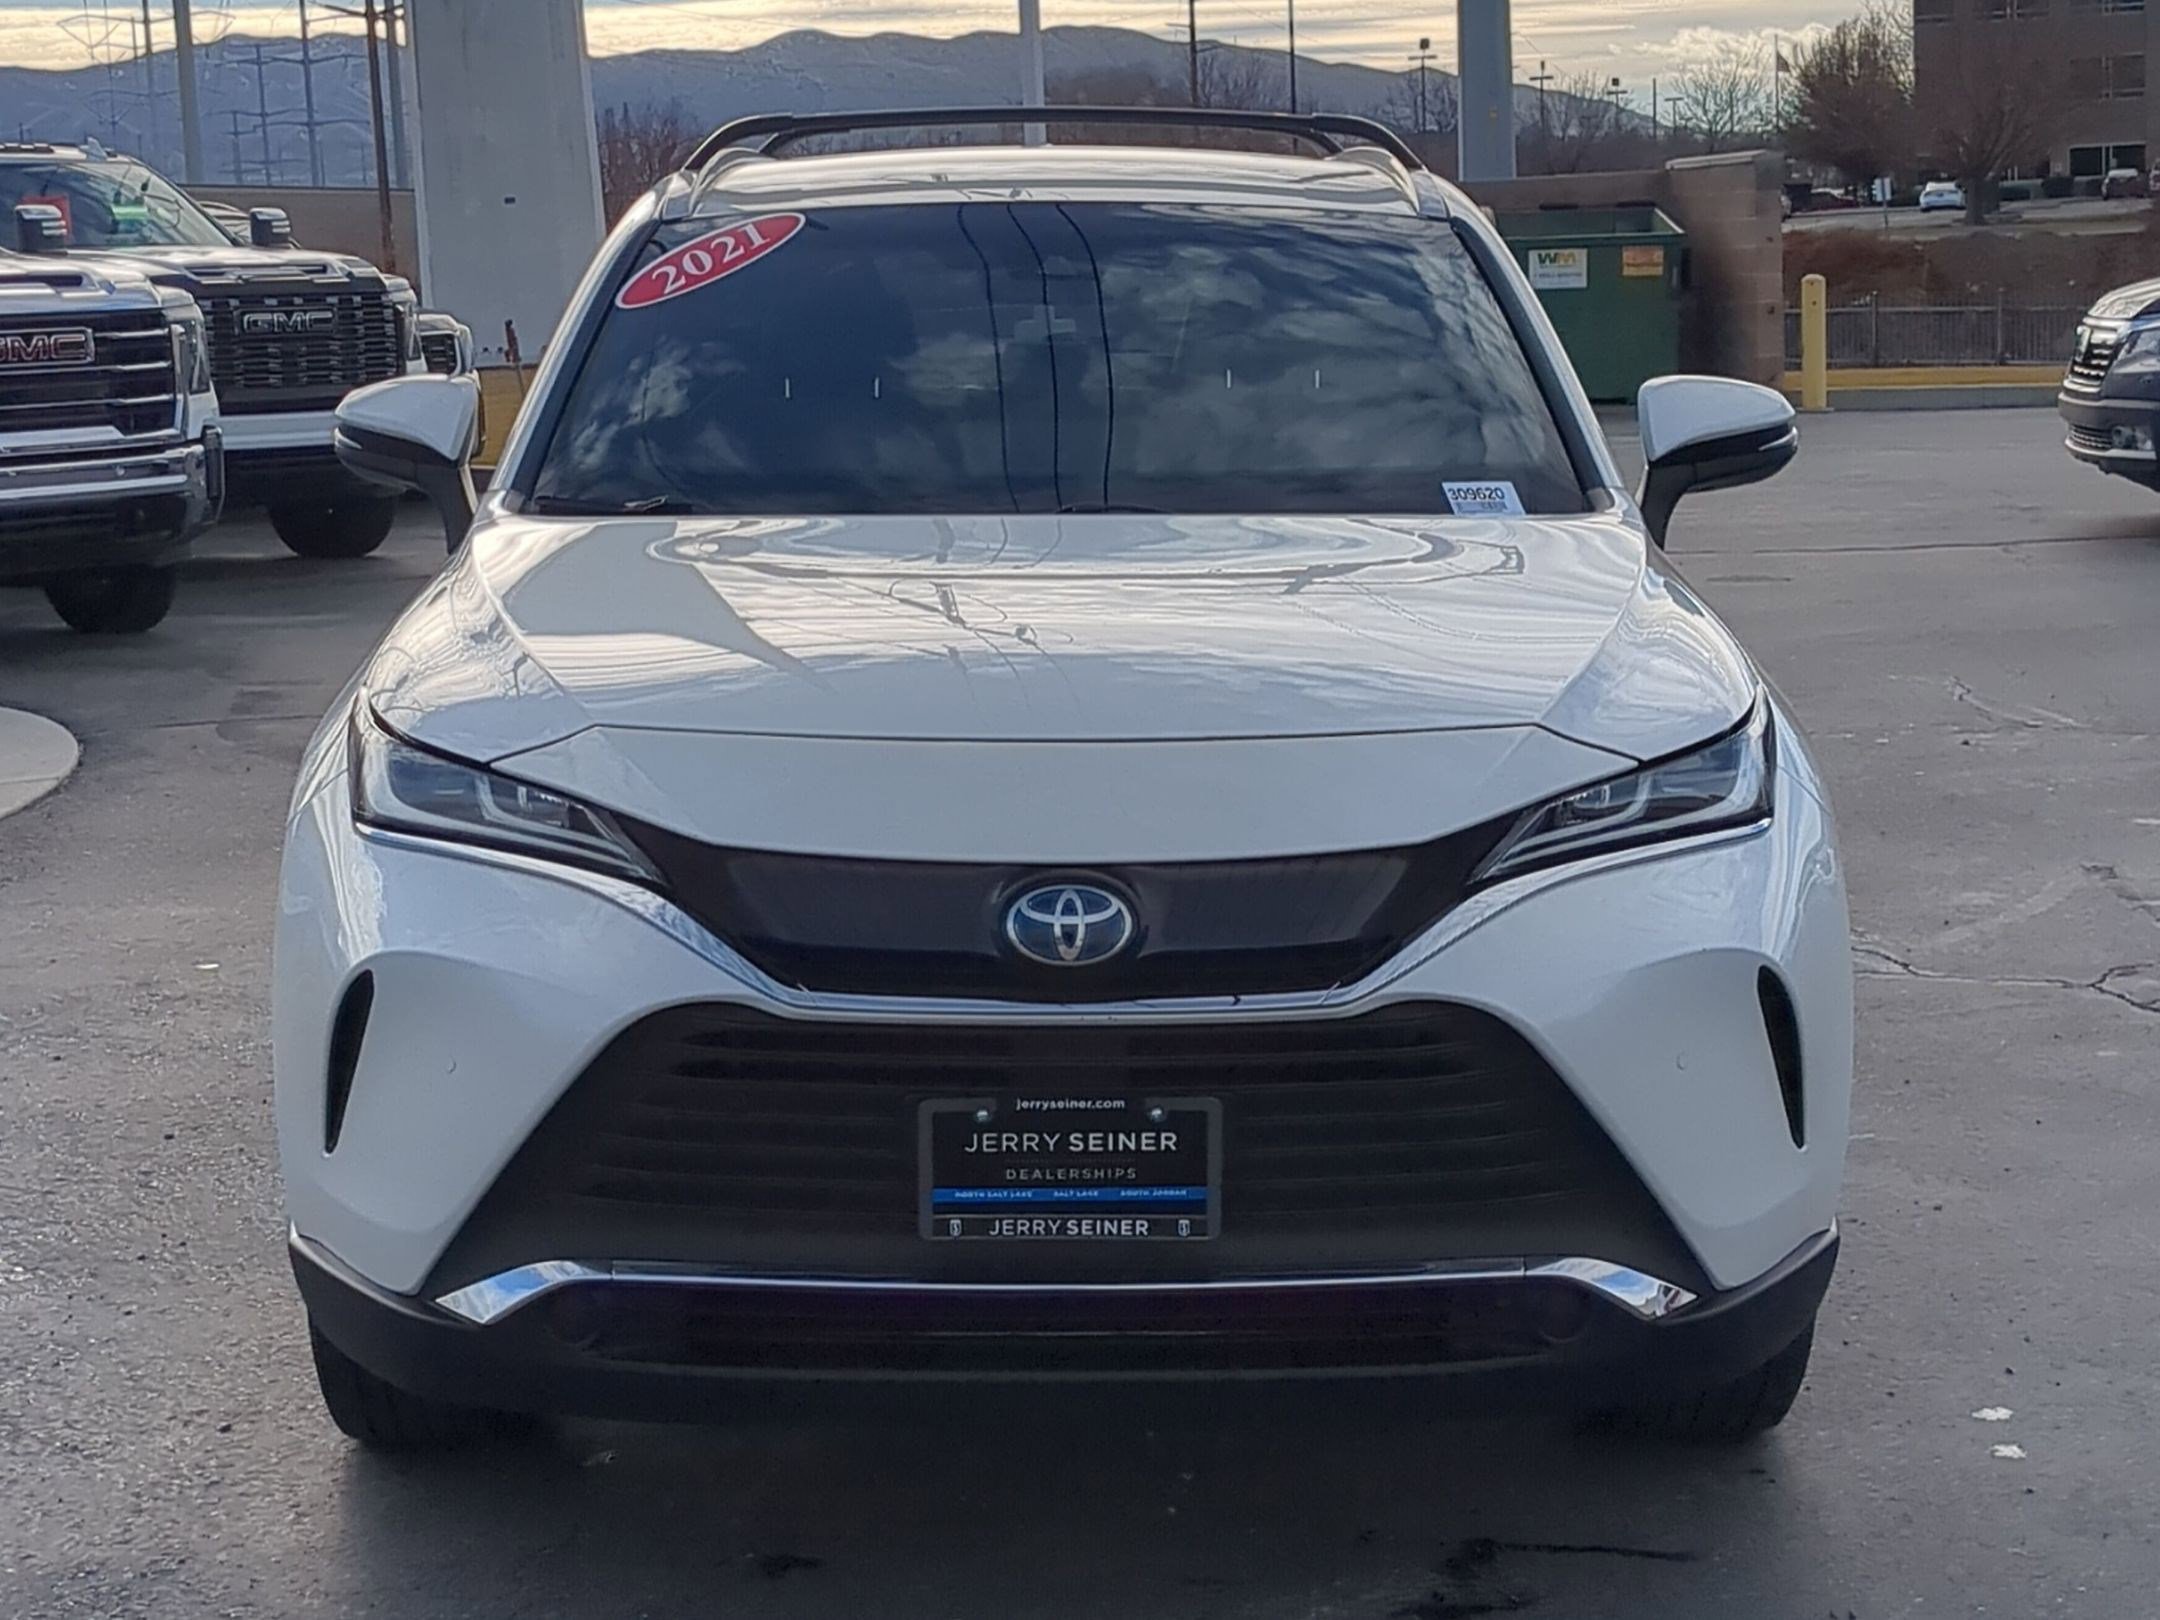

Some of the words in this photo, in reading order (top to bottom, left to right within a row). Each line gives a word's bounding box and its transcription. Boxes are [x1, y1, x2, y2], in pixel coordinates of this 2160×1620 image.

[651, 223, 771, 295] 2021
[1537, 251, 1577, 265] WM
[243, 311, 334, 333] GMC
[0, 334, 86, 361] MC
[1447, 487, 1505, 500] 309620
[1015, 1097, 1125, 1112] jerryseiner.com
[964, 1132, 1062, 1153] JERRY
[1068, 1132, 1178, 1152] SEINER
[1005, 1167, 1137, 1181] DEALERSHIPS
[988, 1219, 1062, 1236] JERRY
[1066, 1219, 1149, 1236] SEINER
